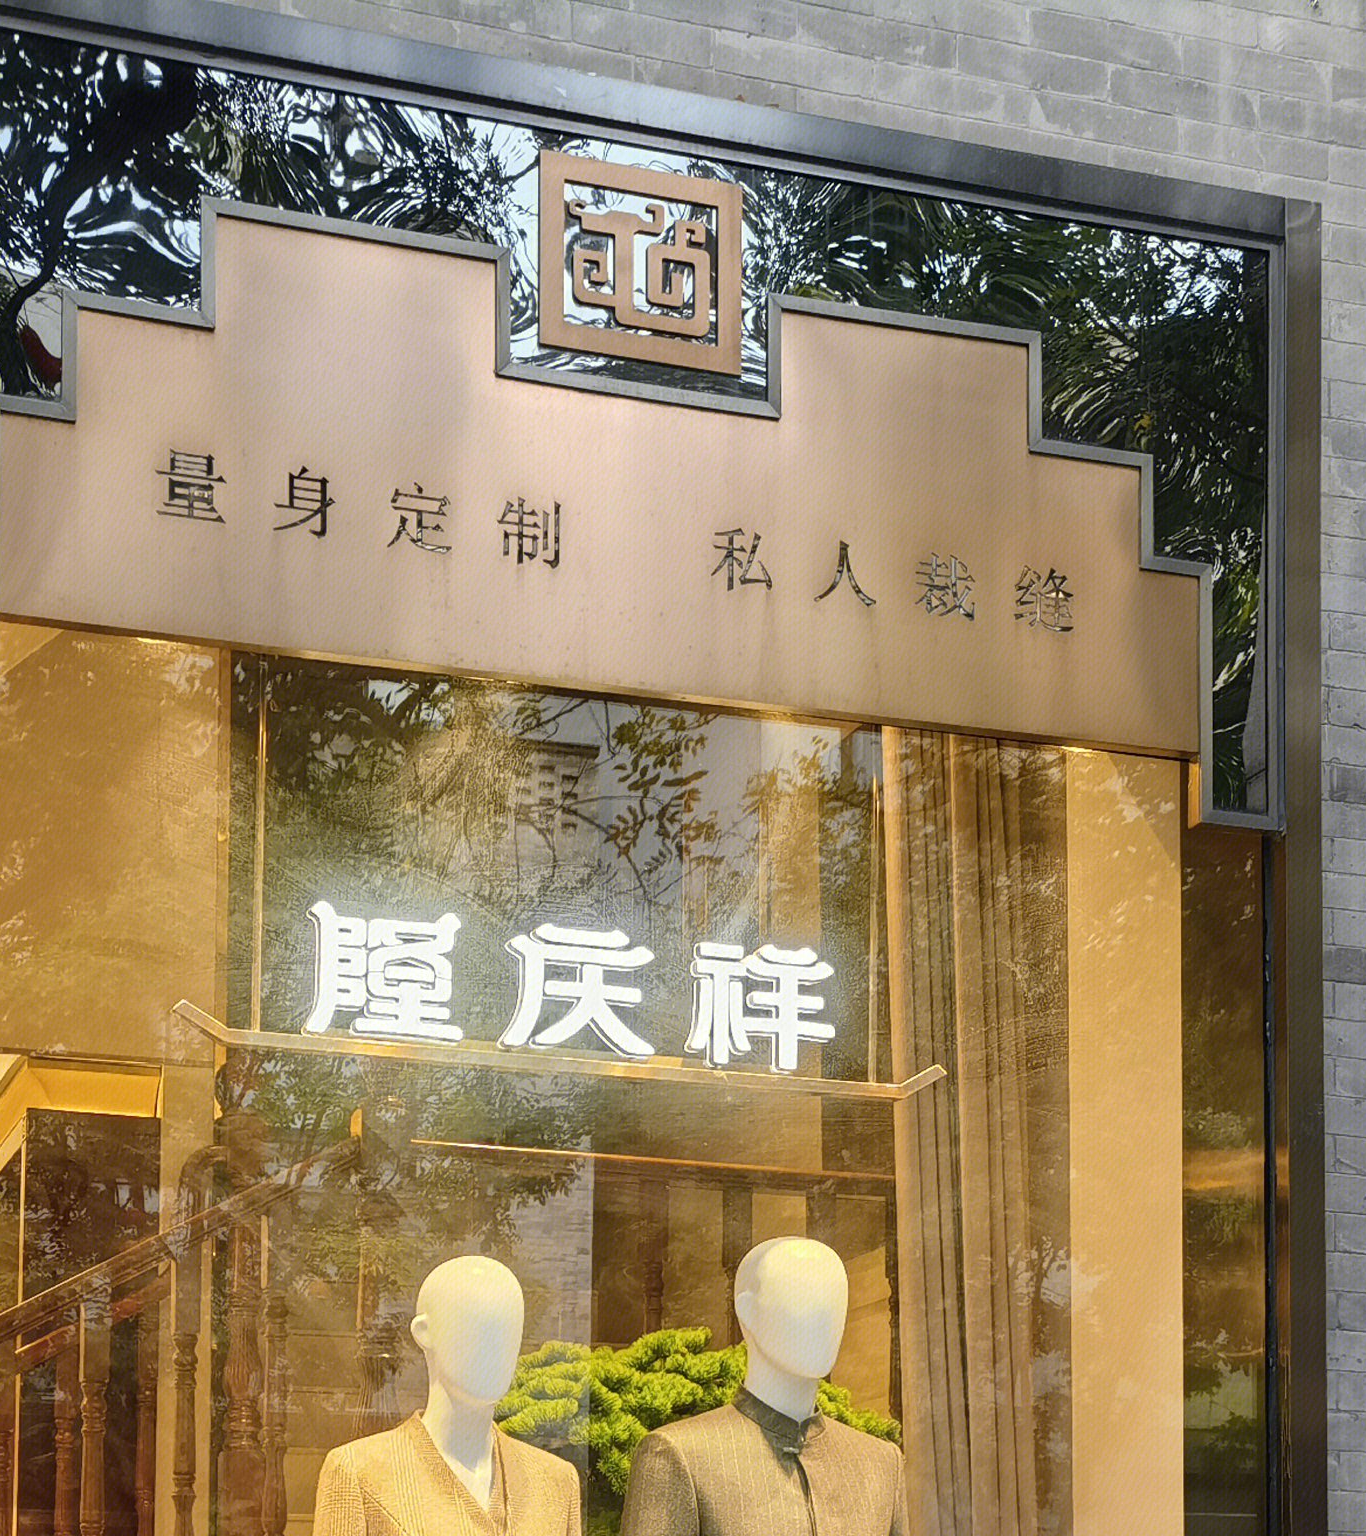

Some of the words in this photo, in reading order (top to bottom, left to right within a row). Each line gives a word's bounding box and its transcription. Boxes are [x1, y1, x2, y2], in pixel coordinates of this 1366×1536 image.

[154, 448, 562, 569] 量身定制
[710, 527, 1075, 633] 私人裁缝
